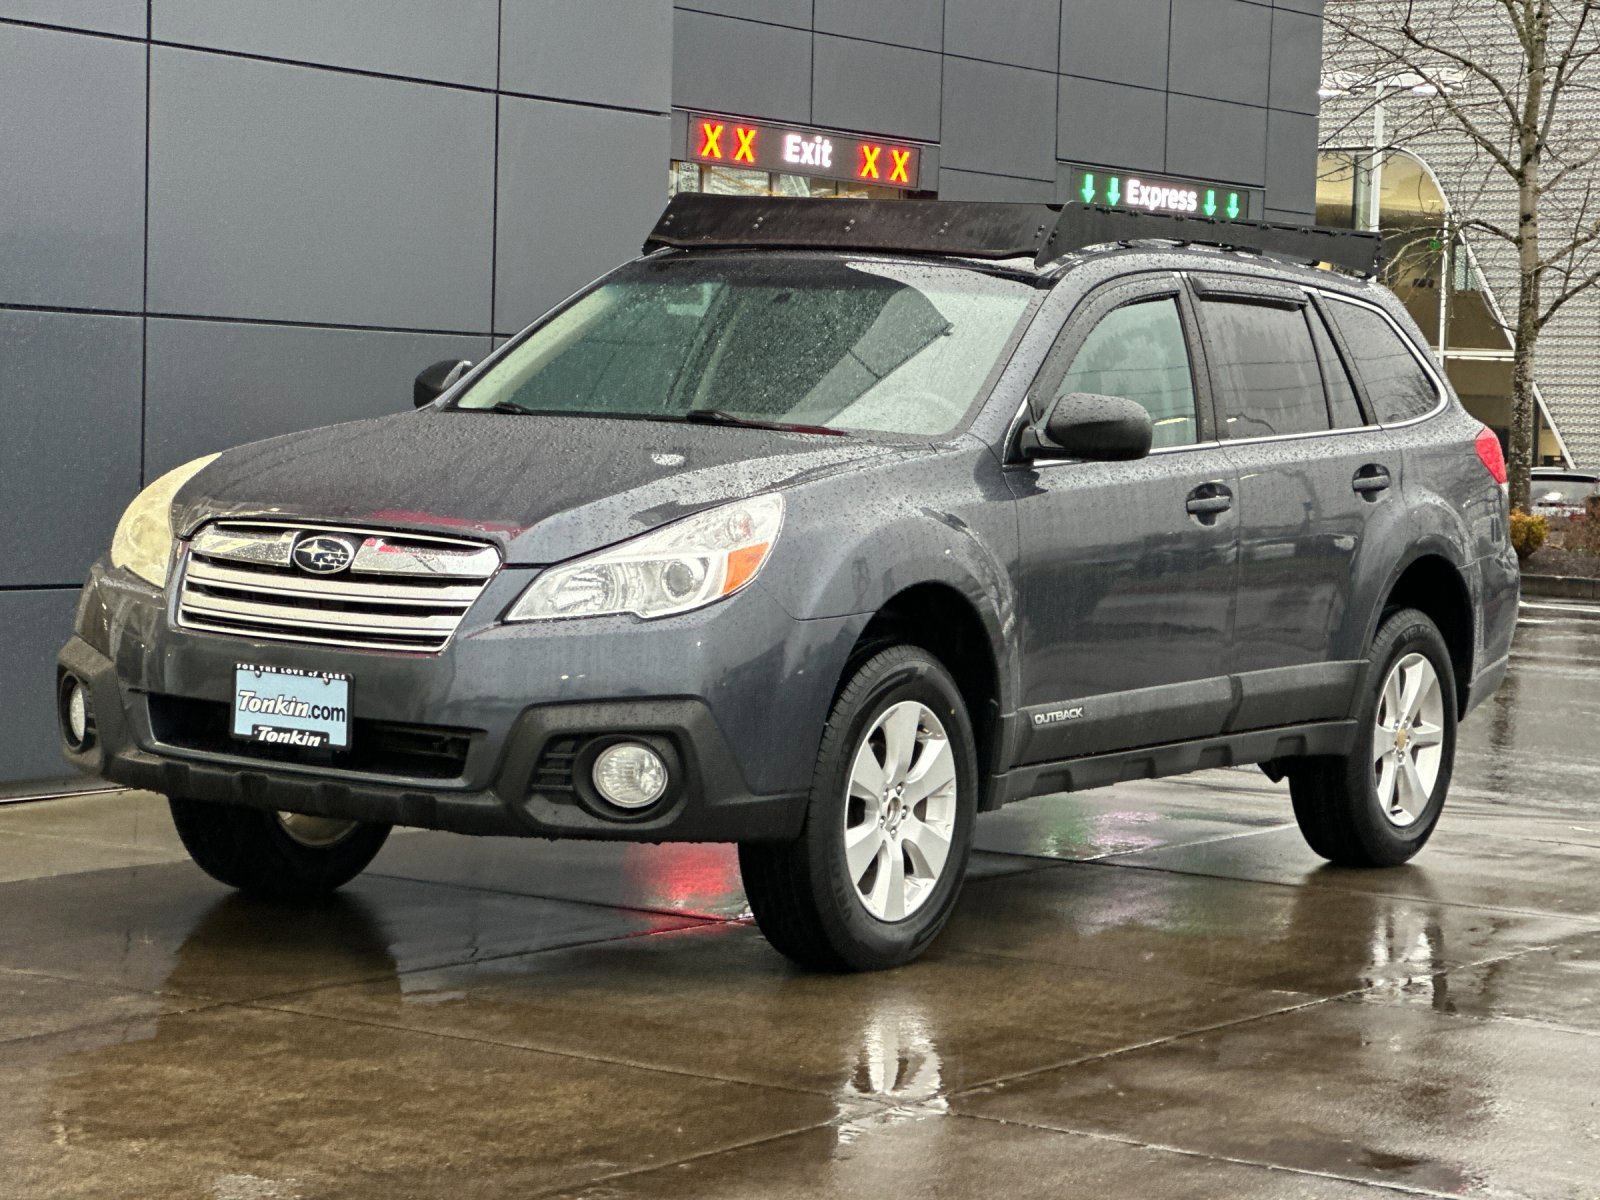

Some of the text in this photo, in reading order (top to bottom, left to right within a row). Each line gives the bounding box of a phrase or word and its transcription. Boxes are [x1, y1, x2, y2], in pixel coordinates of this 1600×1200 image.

[785, 134, 832, 167] Exit
[1126, 178, 1198, 211] Express
[259, 665, 277, 673] THE
[281, 667, 304, 676] LOVE
[322, 672, 346, 680] CARS
[238, 690, 346, 722] Tonkin.com
[1034, 707, 1083, 725] OUTBACK
[258, 726, 321, 747] Tonkin
